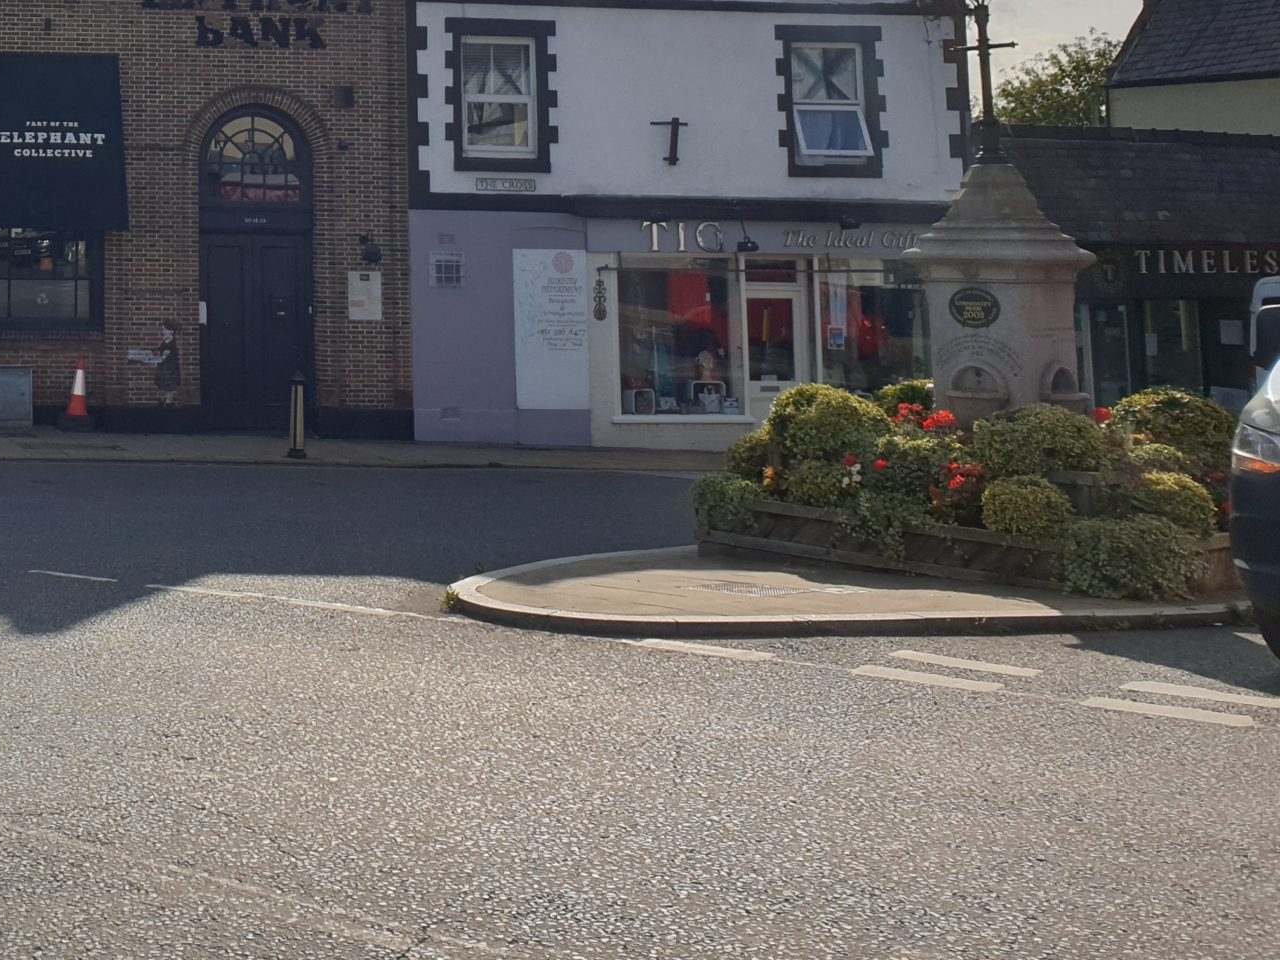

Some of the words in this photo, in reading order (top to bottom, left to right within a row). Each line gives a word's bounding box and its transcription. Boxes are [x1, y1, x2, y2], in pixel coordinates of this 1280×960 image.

[195, 15, 327, 49] BANK
[0, 131, 105, 145] ELEPHANT
[14, 148, 93, 158] COLLECTIVE
[479, 180, 497, 189] THE
[503, 180, 533, 190] CROSS
[641, 221, 724, 252] TIG
[782, 230, 817, 249] The
[825, 229, 874, 249] Ideal
